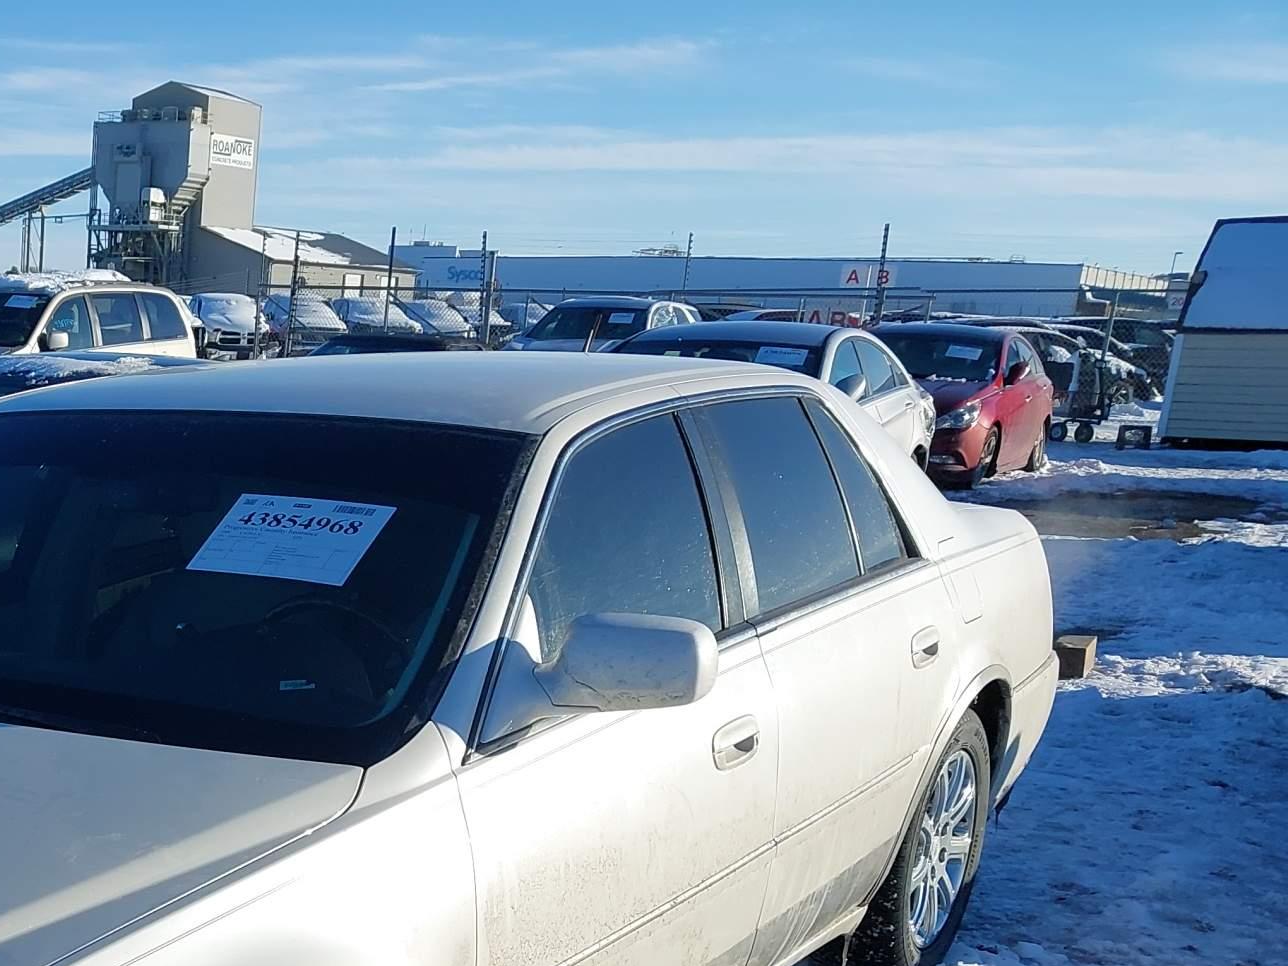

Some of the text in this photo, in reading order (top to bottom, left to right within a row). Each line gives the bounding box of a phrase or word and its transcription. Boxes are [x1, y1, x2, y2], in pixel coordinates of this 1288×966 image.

[212, 139, 253, 156] ROANOKE
[846, 269, 890, 285] A B
[238, 511, 364, 536] 43854968
